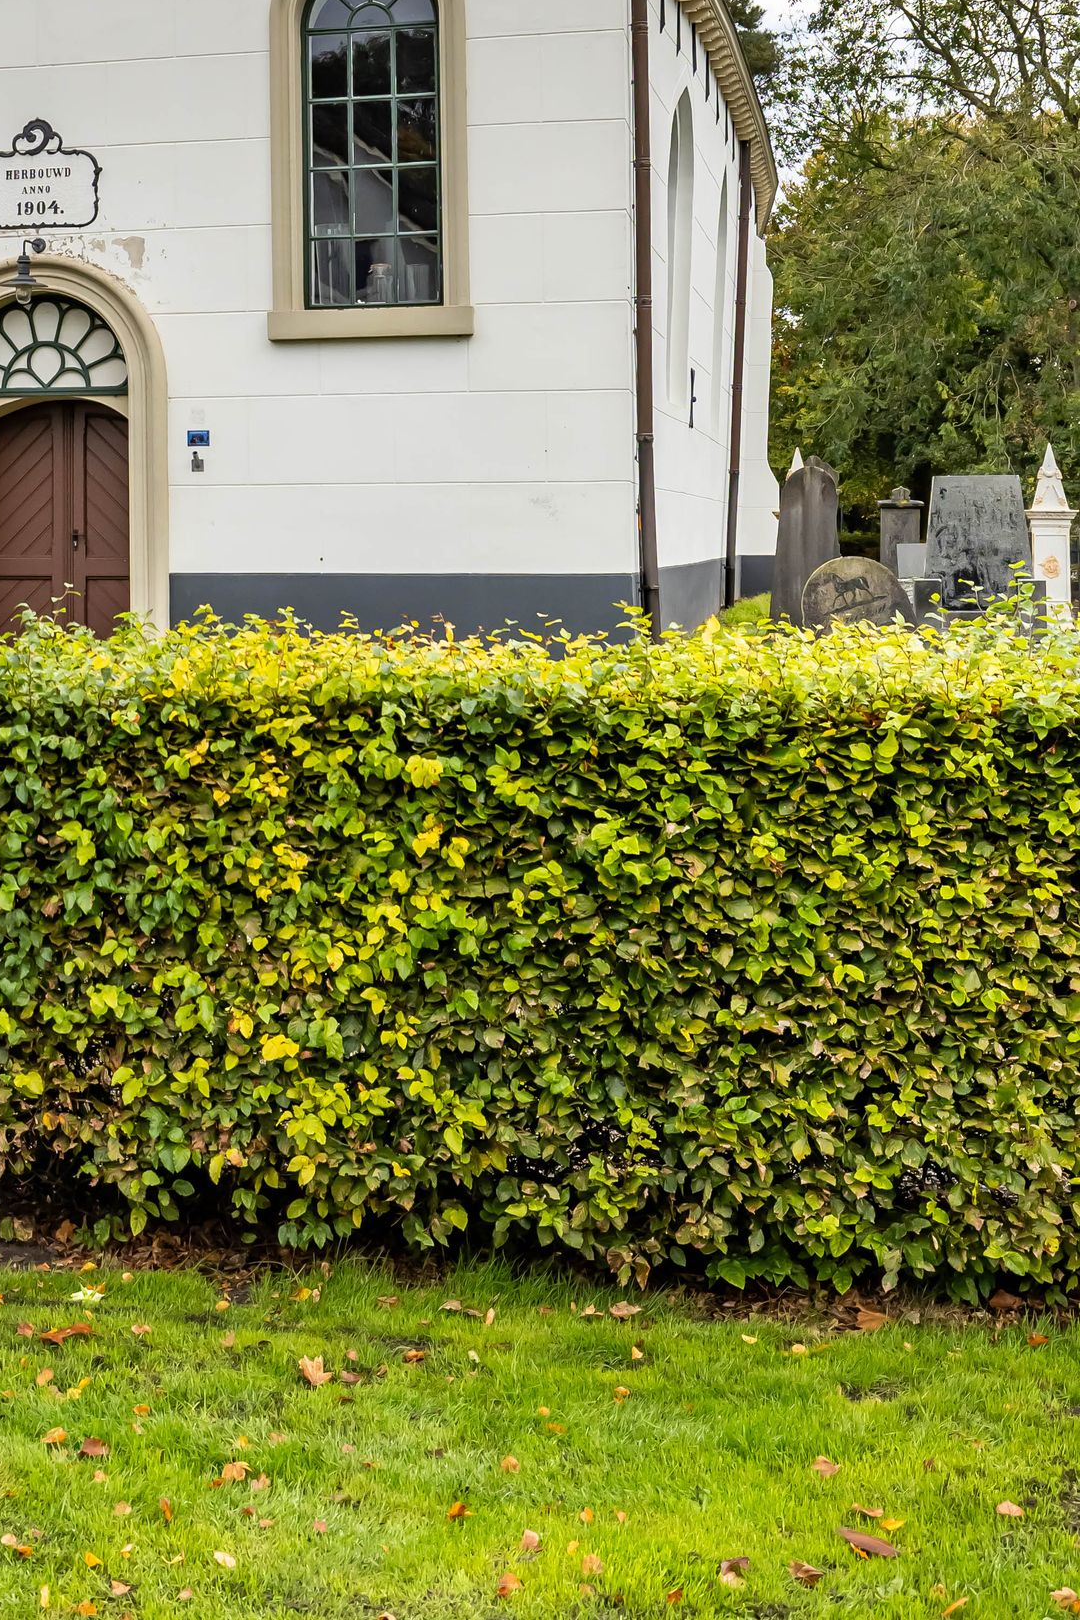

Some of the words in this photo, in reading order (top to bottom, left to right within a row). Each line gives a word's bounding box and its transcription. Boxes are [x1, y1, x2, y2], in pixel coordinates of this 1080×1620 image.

[5, 167, 72, 181] HERBOUWD
[21, 185, 51, 195] ANNO
[16, 200, 65, 216] 1904.
